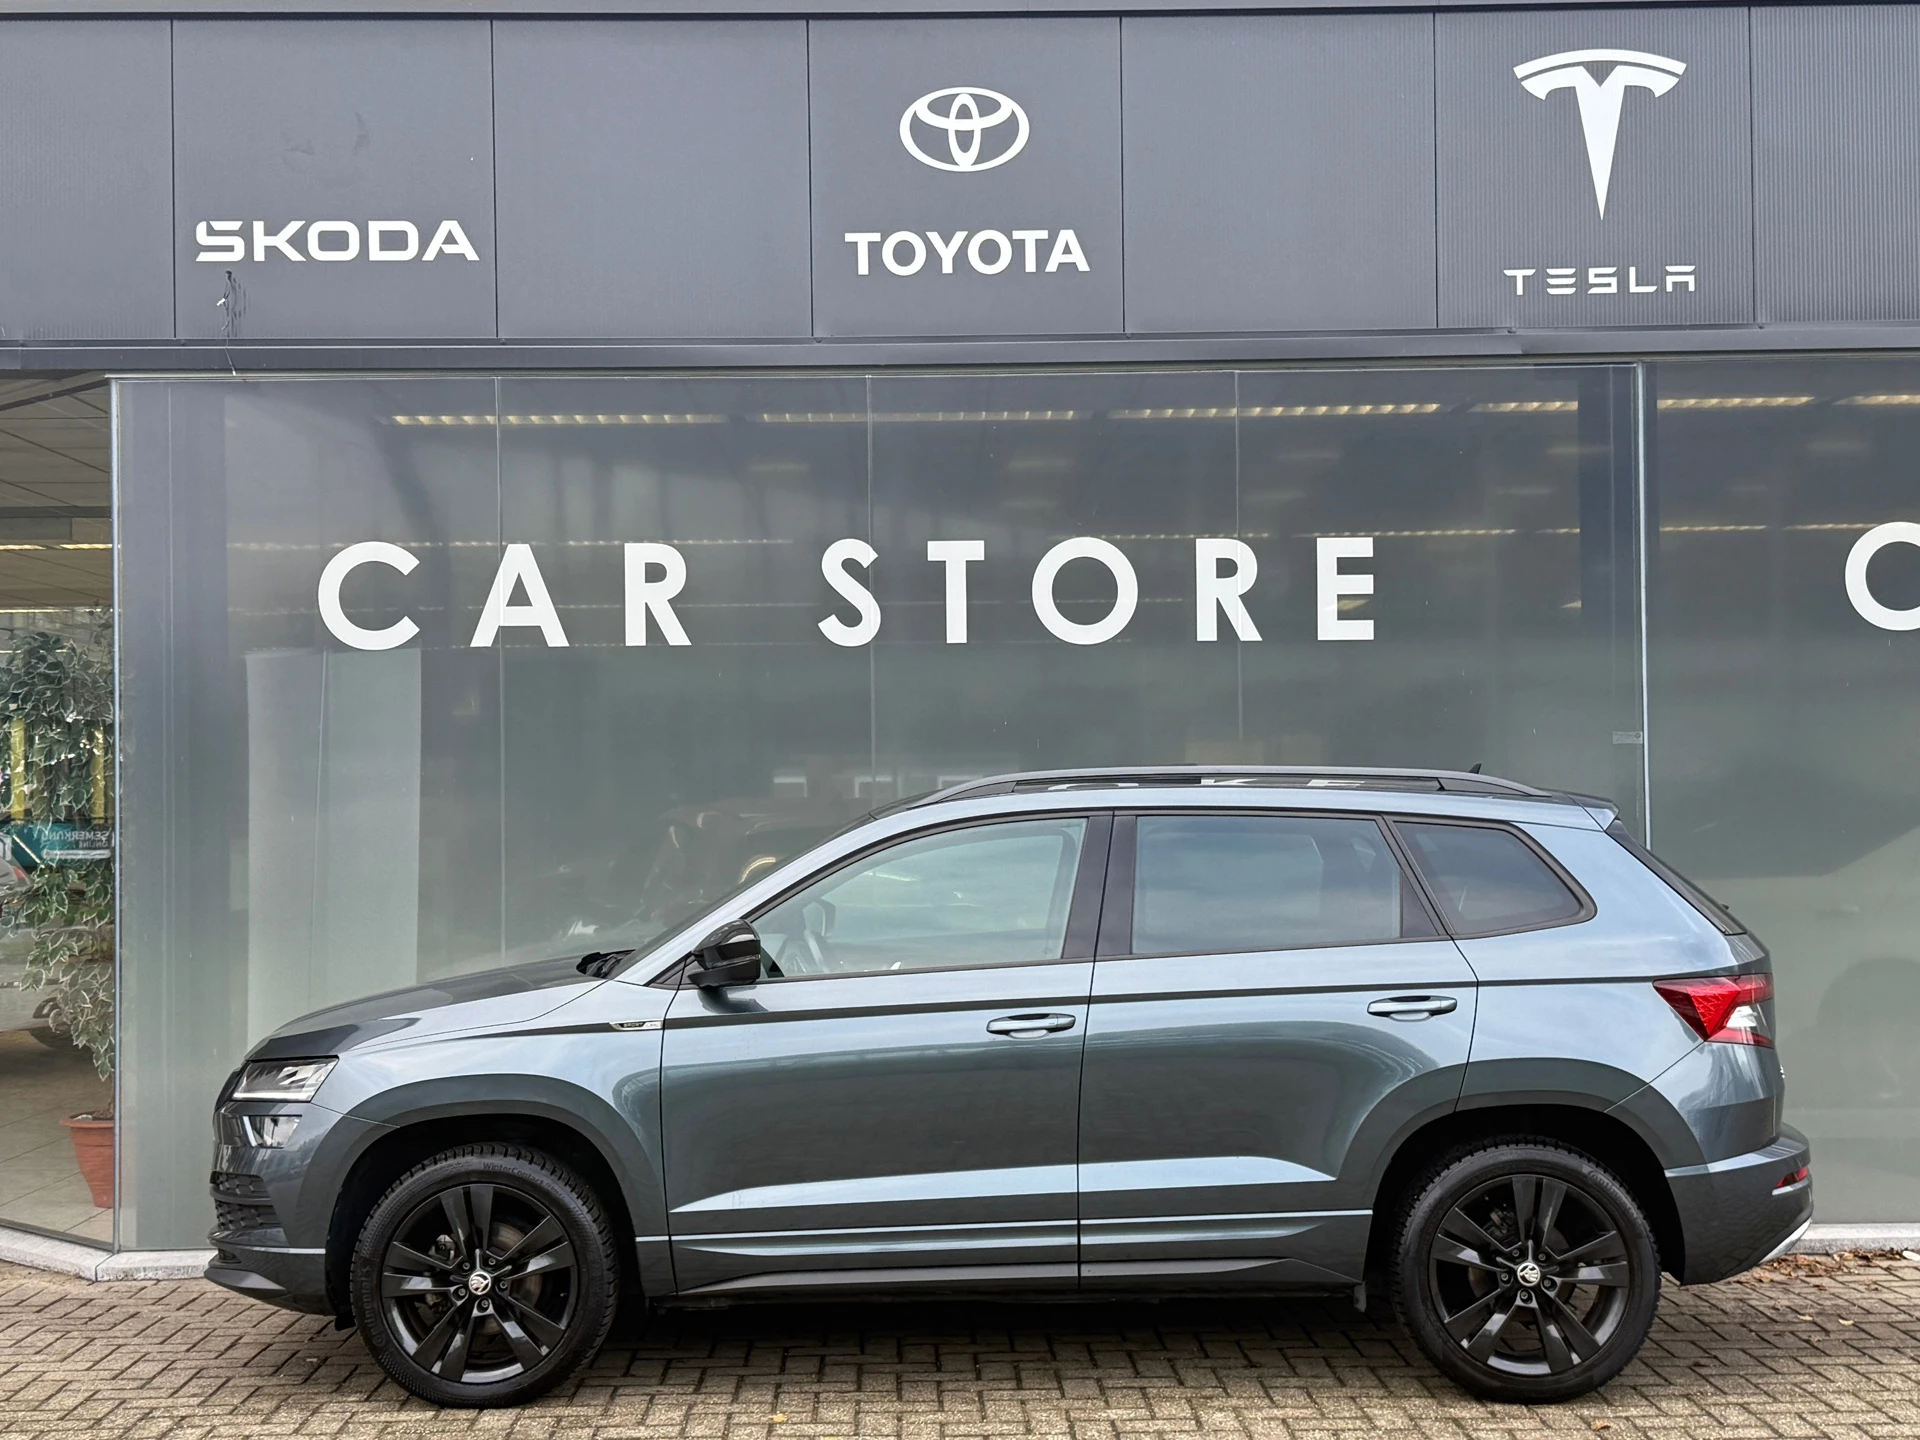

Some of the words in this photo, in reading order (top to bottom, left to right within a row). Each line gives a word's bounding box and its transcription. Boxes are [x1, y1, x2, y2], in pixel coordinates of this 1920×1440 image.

[845, 229, 1090, 276] TOYOTA
[1503, 265, 1696, 296] TESLA
[318, 541, 692, 650] CAR
[818, 537, 1375, 646] STORE
